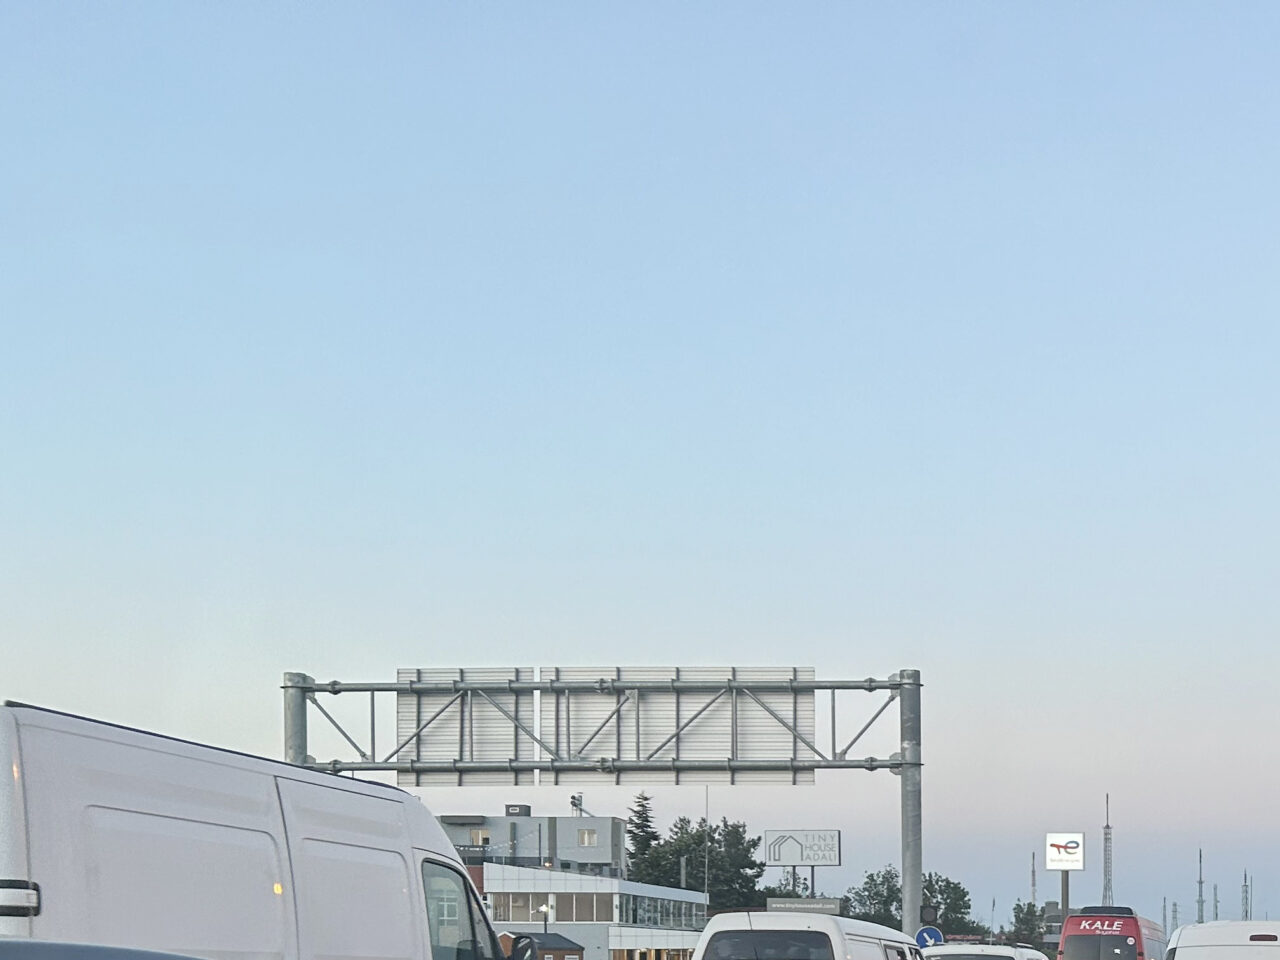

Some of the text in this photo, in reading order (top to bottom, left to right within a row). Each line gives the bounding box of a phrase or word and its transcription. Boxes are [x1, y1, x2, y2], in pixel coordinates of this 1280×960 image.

[804, 833, 836, 842] TINY
[804, 843, 836, 852] HOUSE
[804, 853, 837, 861] ADALI
[1079, 920, 1123, 930] KALE
